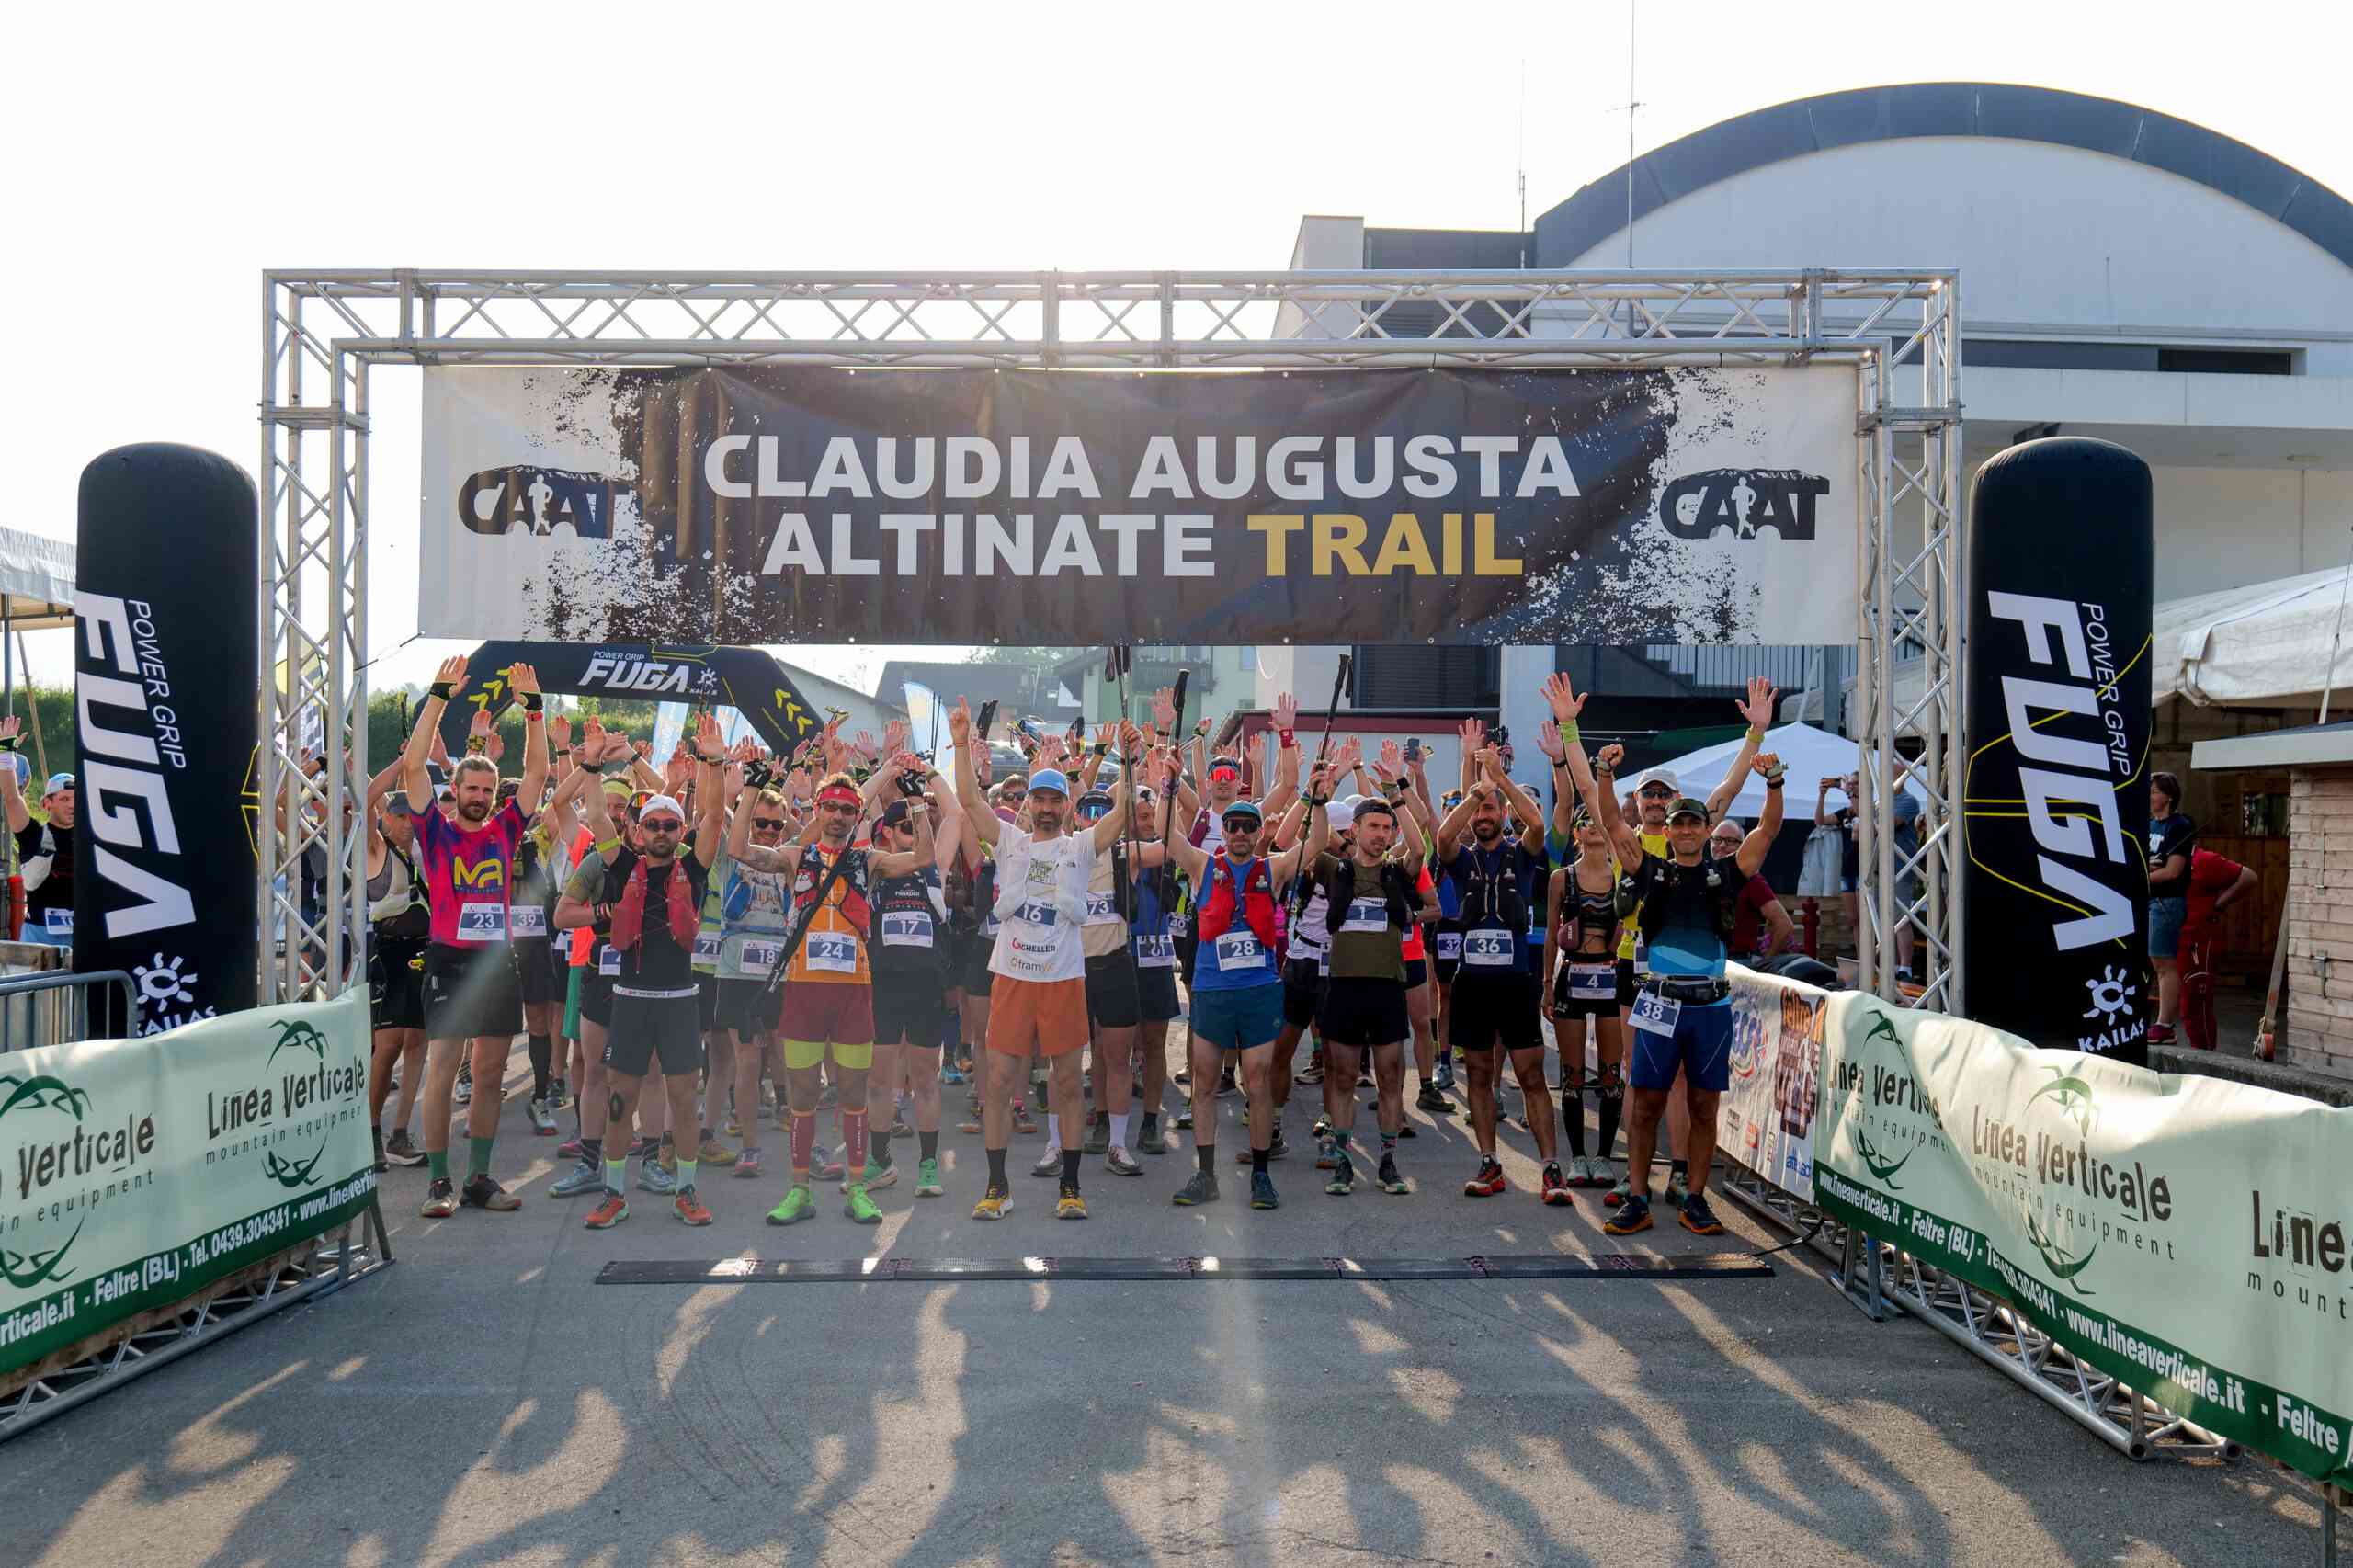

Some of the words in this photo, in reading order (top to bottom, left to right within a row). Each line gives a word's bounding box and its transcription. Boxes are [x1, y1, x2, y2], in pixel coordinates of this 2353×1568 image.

[704, 434, 1101, 499] CLAUDIA
[1129, 435, 1579, 500] AUGUSTA
[762, 512, 1215, 577] ALTINATE
[1248, 512, 1523, 576] TRAIL
[593, 651, 623, 660] POWER
[624, 653, 645, 662] GRIP
[128, 598, 170, 699] POWER
[153, 703, 187, 770] GRIP
[577, 658, 689, 693] FUGA
[2082, 601, 2120, 705] POWER
[2105, 708, 2131, 777] GRIP
[74, 590, 197, 939] FUGA
[1987, 590, 2135, 951] FUGA
[472, 913, 495, 928] 23
[518, 915, 537, 927] 39
[1023, 904, 1042, 922] 16
[1087, 900, 1109, 915] 73
[900, 920, 920, 934] 17
[701, 940, 720, 954] 71
[758, 949, 776, 964] 18
[820, 942, 844, 960] 24
[1232, 940, 1255, 957] 28
[1477, 938, 1501, 953] 36
[1586, 974, 1599, 988] 4
[1641, 1002, 1664, 1021] 38
[2078, 1017, 2144, 1052] KAILAS
[208, 1087, 273, 1141] Linea
[283, 1055, 366, 1118] Verticale
[18, 1112, 155, 1200] Verticale
[206, 1128, 286, 1165] mountain
[1972, 1104, 2028, 1169] Linea
[2037, 1131, 2172, 1222] Verticale
[38, 1168, 153, 1221] equipment
[1975, 1167, 2043, 1210] mountain
[2055, 1203, 2175, 1260] equipment
[2252, 1189, 2353, 1273] Line
[95, 1270, 139, 1307] Feltre
[142, 1251, 180, 1290] (BL)
[189, 1243, 209, 1268] Tel.
[211, 1205, 290, 1258] 0439.304341
[1819, 1172, 1900, 1226] www.lineaverticale.it
[1912, 1210, 1945, 1246] Feltre
[1948, 1226, 1975, 1262] (BL)
[2066, 1307, 2245, 1414] www.lineaverticale.it
[2277, 1393, 2339, 1454] Feltre
